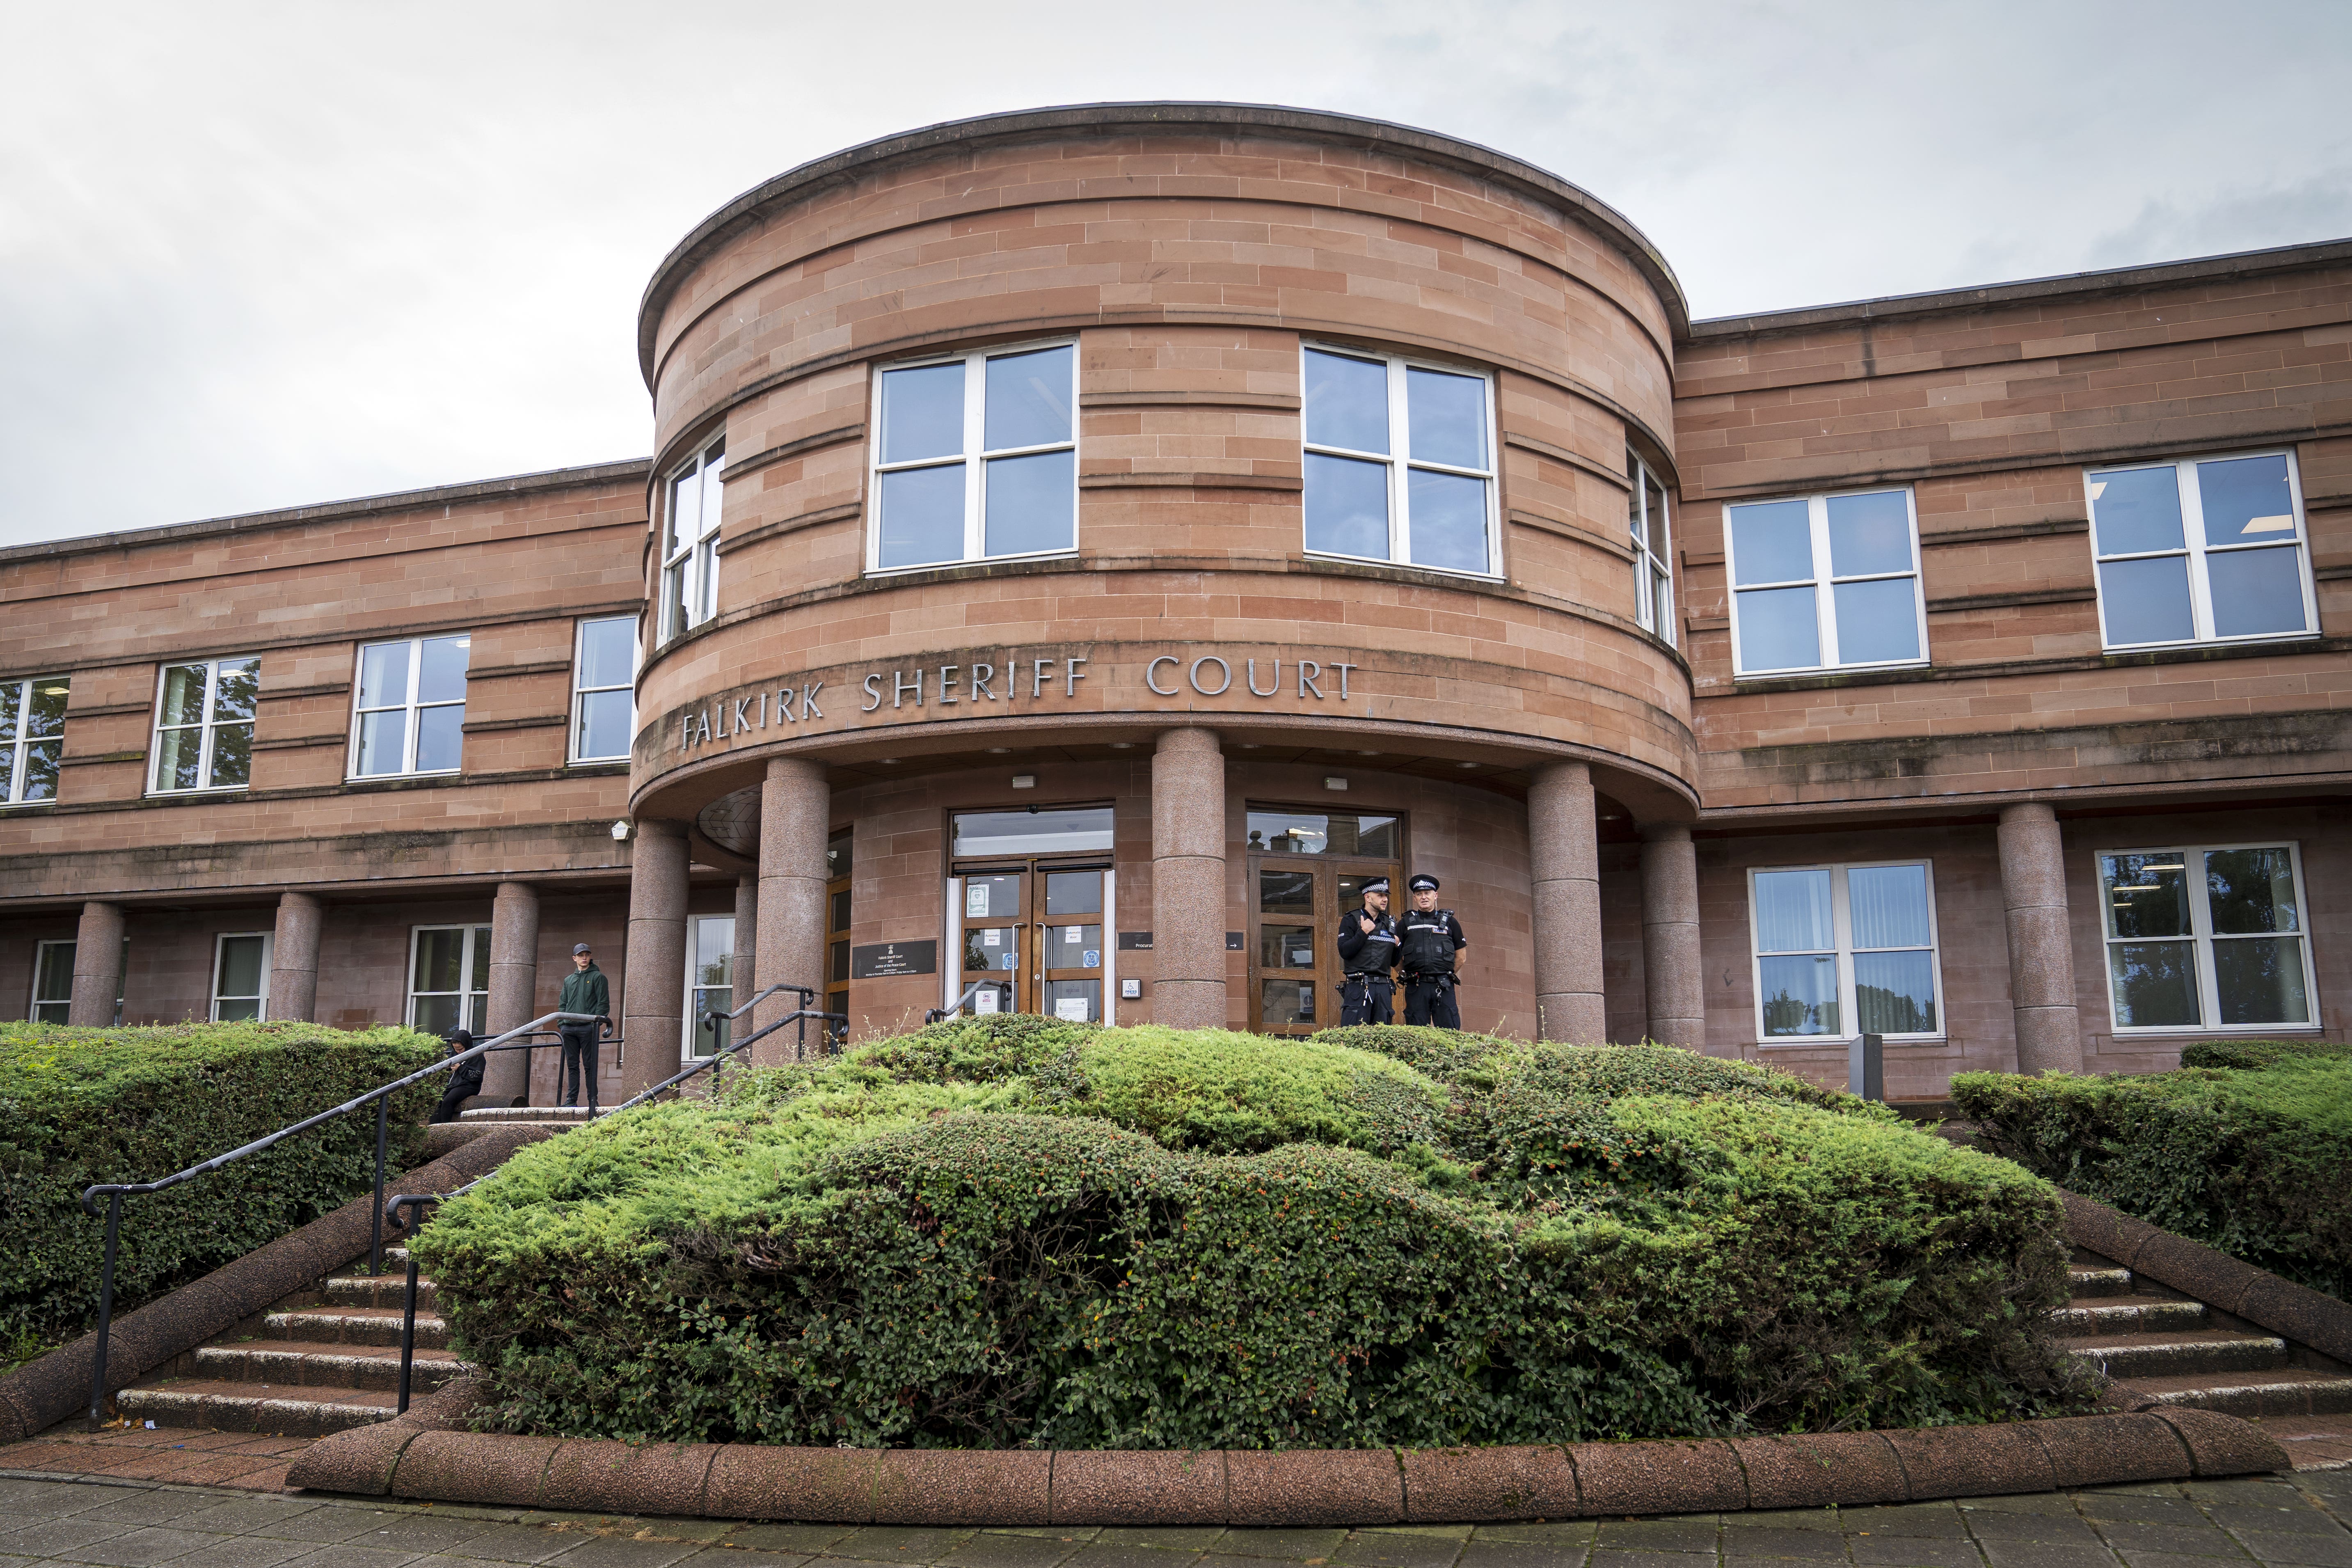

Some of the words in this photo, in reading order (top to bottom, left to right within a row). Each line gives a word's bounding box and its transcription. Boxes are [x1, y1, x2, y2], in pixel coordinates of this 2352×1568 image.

[683, 682, 824, 750] FALKIRK
[862, 658, 1087, 711] SHERIFF
[1146, 656, 1357, 700] COURT
